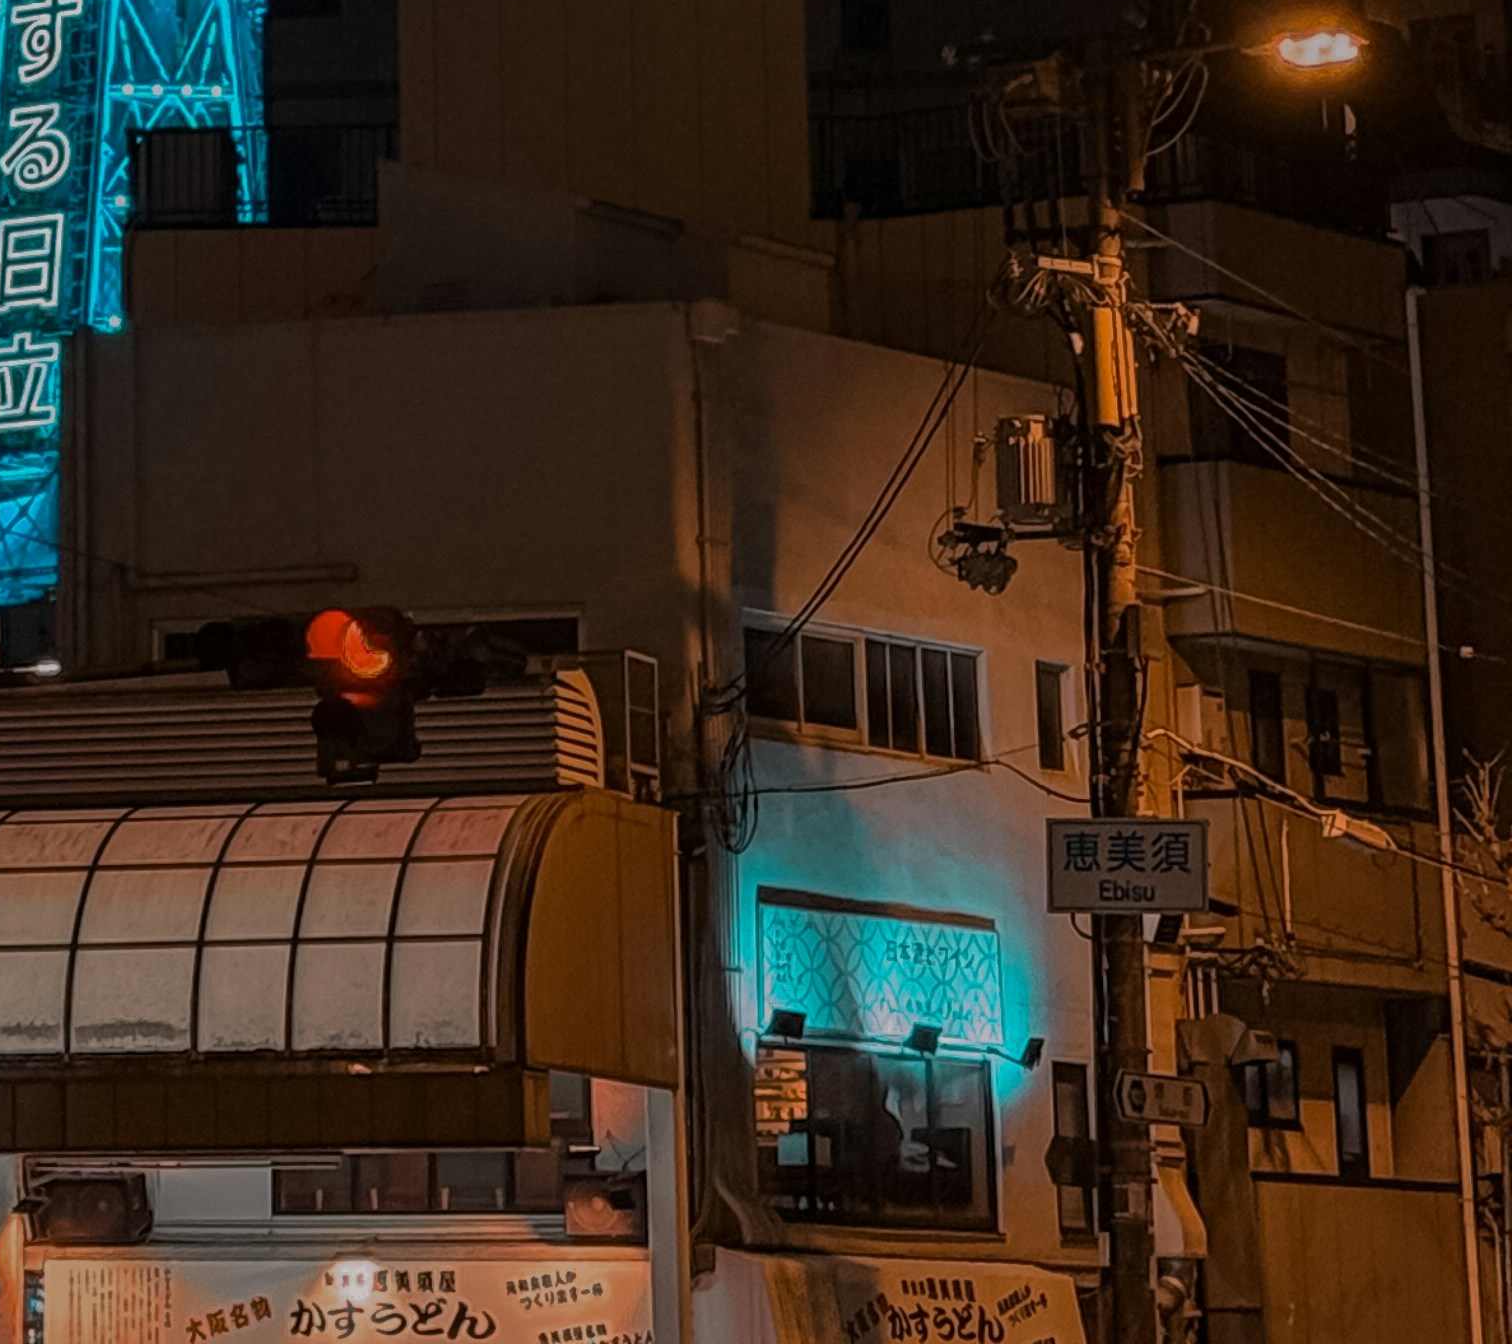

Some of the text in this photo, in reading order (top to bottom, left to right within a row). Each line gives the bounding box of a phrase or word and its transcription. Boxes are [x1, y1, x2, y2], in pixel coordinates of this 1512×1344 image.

[1063, 830, 1191, 873] 恵美須
[1099, 879, 1156, 902] Ebisu
[290, 1298, 496, 1340] かすうどん
[888, 1302, 1005, 1344] かすうどん
